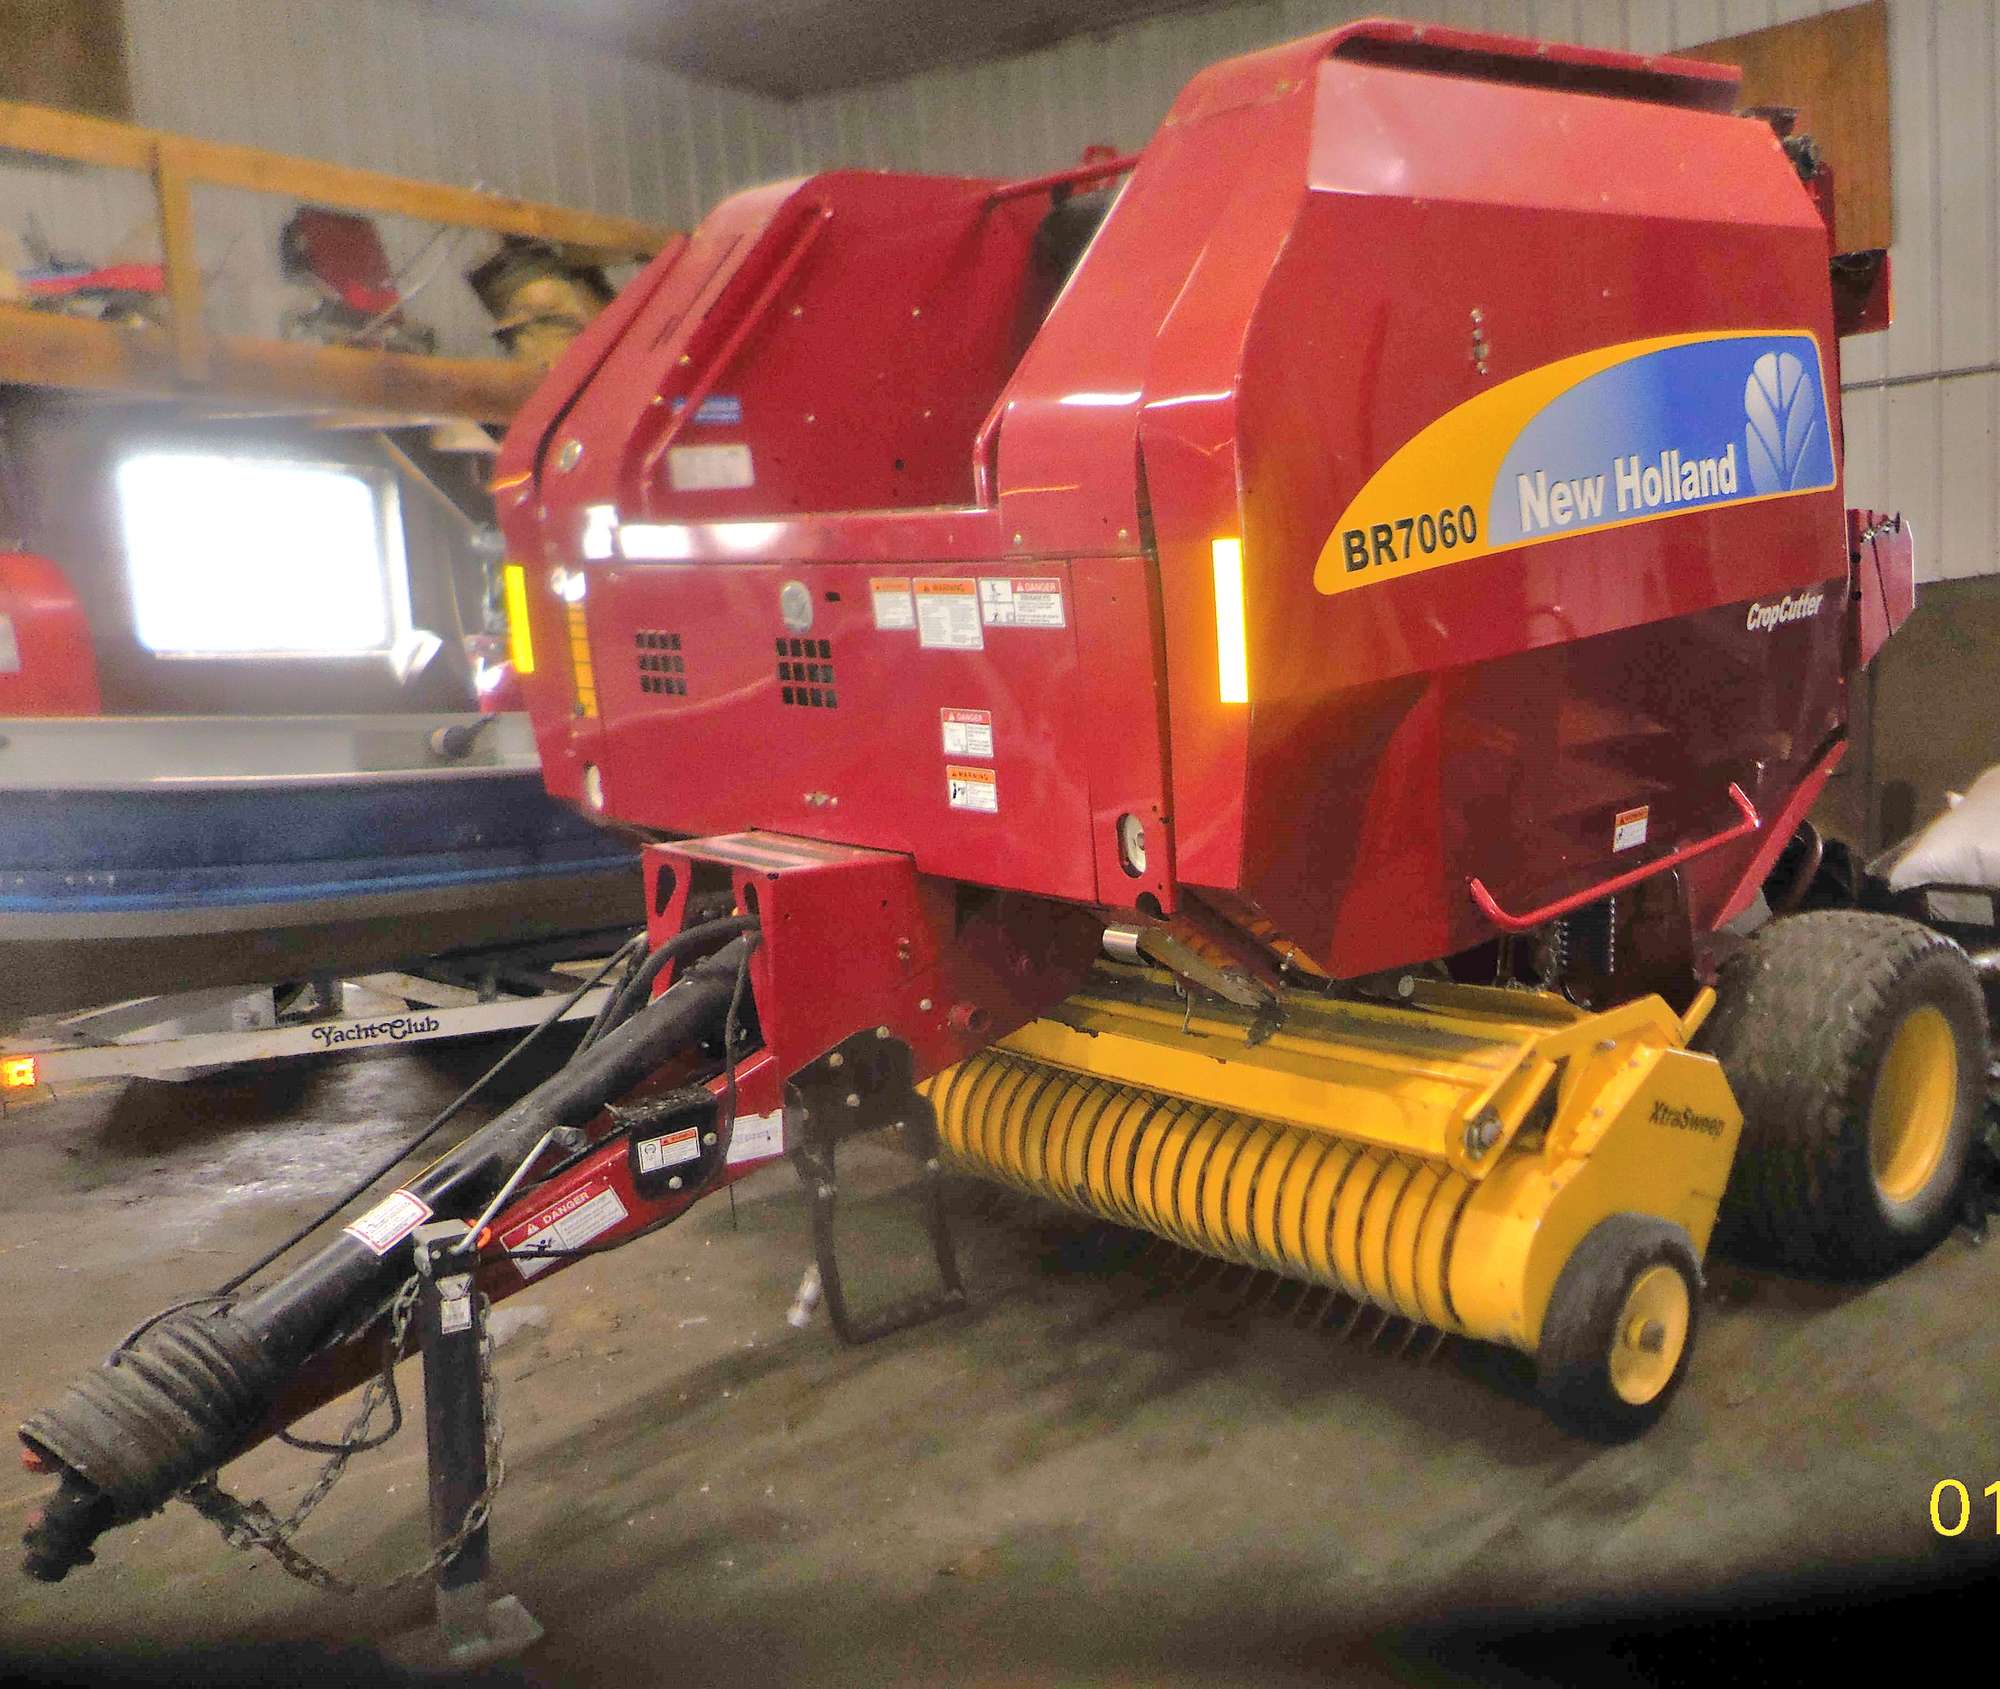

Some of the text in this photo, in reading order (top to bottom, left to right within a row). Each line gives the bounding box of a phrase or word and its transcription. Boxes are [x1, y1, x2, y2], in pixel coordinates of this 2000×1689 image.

[1516, 443, 1738, 533] New Holland
[1342, 504, 1477, 573] BR7060
[1024, 582, 1056, 593] DANGER
[1746, 592, 1824, 632] CropCutter
[312, 1016, 440, 1047] Yacht Club
[1649, 1099, 1726, 1138] XtraSweep
[543, 1191, 590, 1225] DANGER
